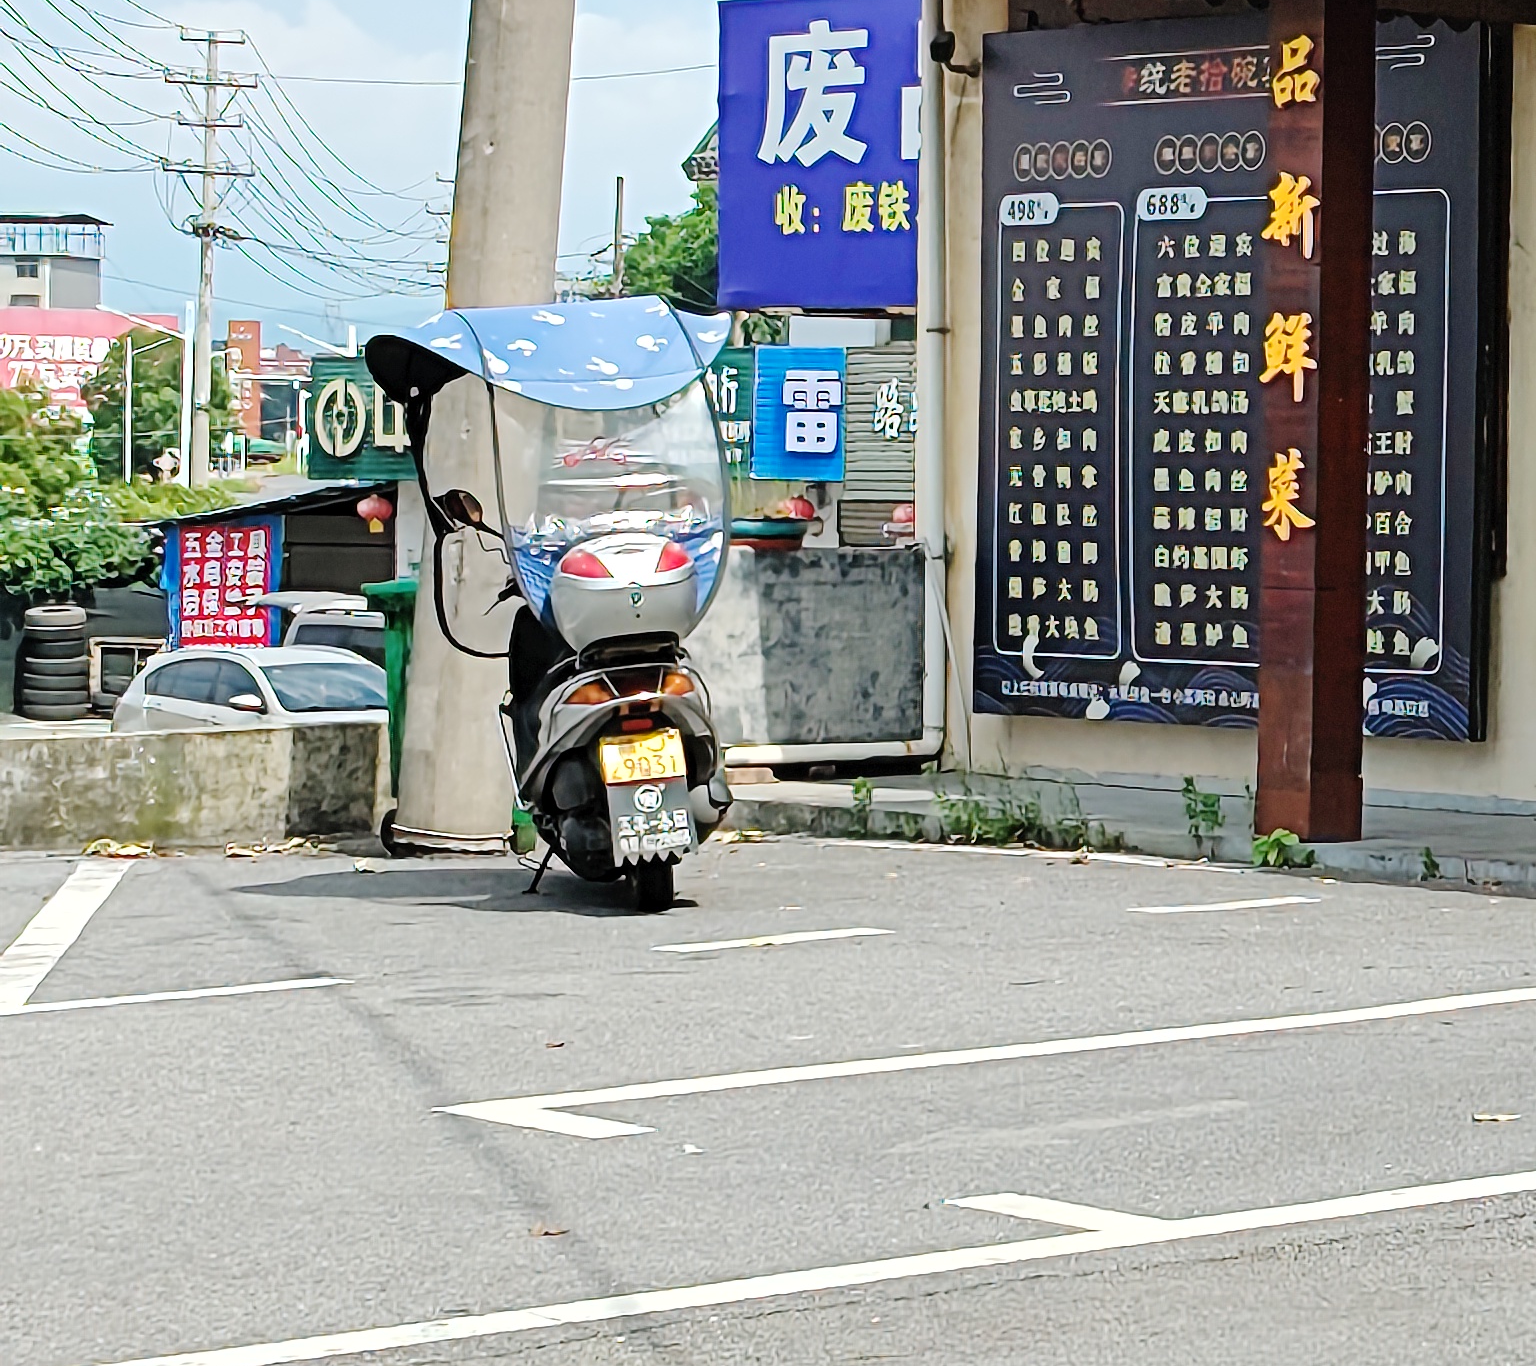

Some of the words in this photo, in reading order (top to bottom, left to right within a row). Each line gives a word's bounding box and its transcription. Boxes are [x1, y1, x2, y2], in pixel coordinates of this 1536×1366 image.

[757, 20, 921, 167] 废
[1259, 34, 1321, 541] 品新鲜菜
[782, 369, 843, 454] 雷
[1366, 550, 1412, 576] 甲鱼
[1367, 510, 1413, 536] 百合
